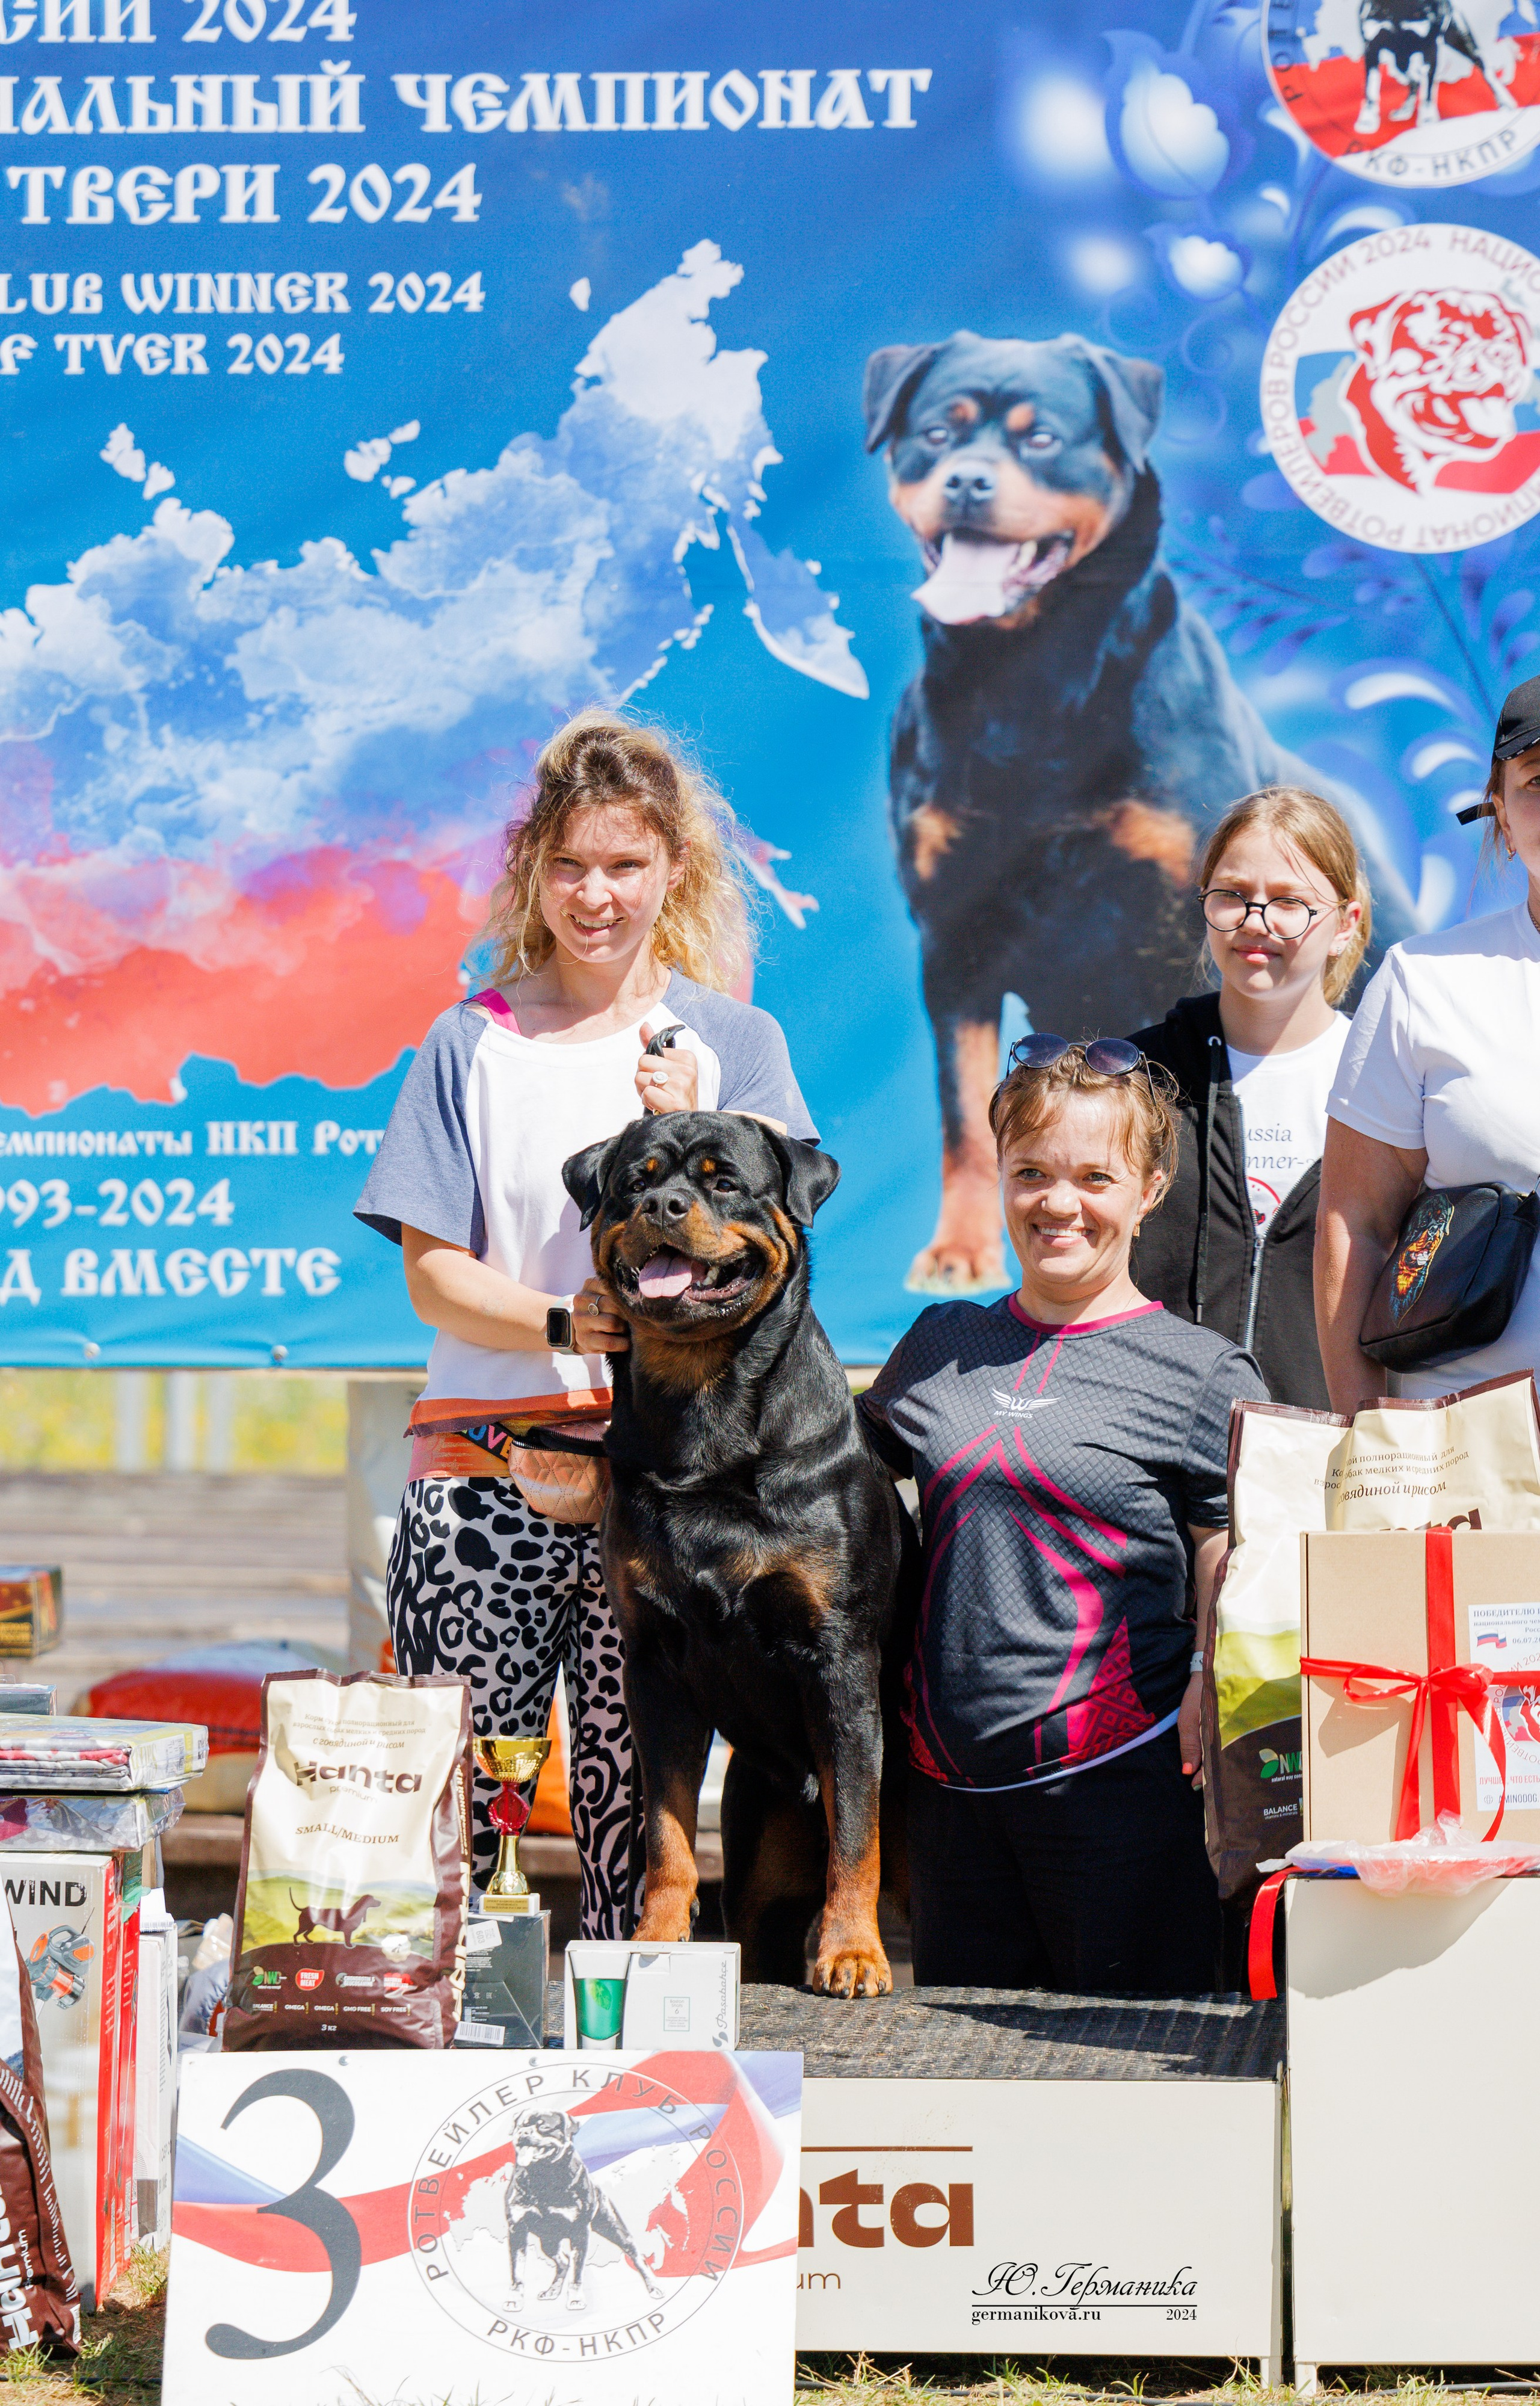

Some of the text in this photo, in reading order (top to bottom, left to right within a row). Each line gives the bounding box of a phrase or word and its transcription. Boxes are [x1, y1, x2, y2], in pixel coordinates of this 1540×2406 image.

[182, 0, 357, 43] 2024
[390, 68, 934, 135] ЧЕМПИОНАТ
[1344, 129, 1517, 179] РКФ-НКПР
[7, 162, 483, 226] ТВЕРИ 2024
[1359, 229, 1432, 265] 2024
[121, 273, 352, 315] WINNER
[368, 271, 486, 314] 2024
[1268, 256, 1358, 369] РОССИИ
[53, 333, 210, 375] TVER
[226, 333, 345, 375] 2024
[1267, 379, 1405, 544] РОТВЕЙЛЕРОВ
[0, 1130, 193, 1158] мпионаты
[206, 1120, 299, 1156] НКП
[0, 1177, 235, 1229] 93-2024
[0, 1247, 342, 1307] Д ВМЕСТЕ
[1341, 1468, 1363, 1481] обак
[1365, 1464, 1404, 1475] мелких
[1412, 1464, 1445, 1475] средних
[1444, 1450, 1470, 1469] пород
[1360, 1451, 1438, 1463] полнорационный
[1441, 1446, 1455, 1460] для
[1314, 1478, 1342, 1490] взрос
[1411, 1481, 1447, 1498] рисом
[1474, 1608, 1535, 1618] ПОБЕДИТЕЛЮ
[292, 1722, 327, 1731] взрослых
[407, 1727, 426, 1735] пород
[304, 1713, 324, 1723] Корм
[342, 1719, 402, 1728] полнорационный
[313, 1736, 319, 1745] с
[319, 1736, 368, 1748] говядиной
[377, 1739, 405, 1749] рисом
[294, 1760, 423, 1794] Hanta
[329, 1784, 378, 1804] premium
[1510, 1775, 1523, 1784] ЧТО
[1263, 1803, 1298, 1816] BALANCE
[295, 1822, 400, 1844] SMALL/MEDIUM
[301, 1972, 319, 1980] FRESH
[413, 2068, 739, 2284] РОТВЕЙЛЕР КЛУБ РОССИИ
[205, 2068, 362, 2360] 3
[486, 2310, 668, 2358] РКФ-НКПР
